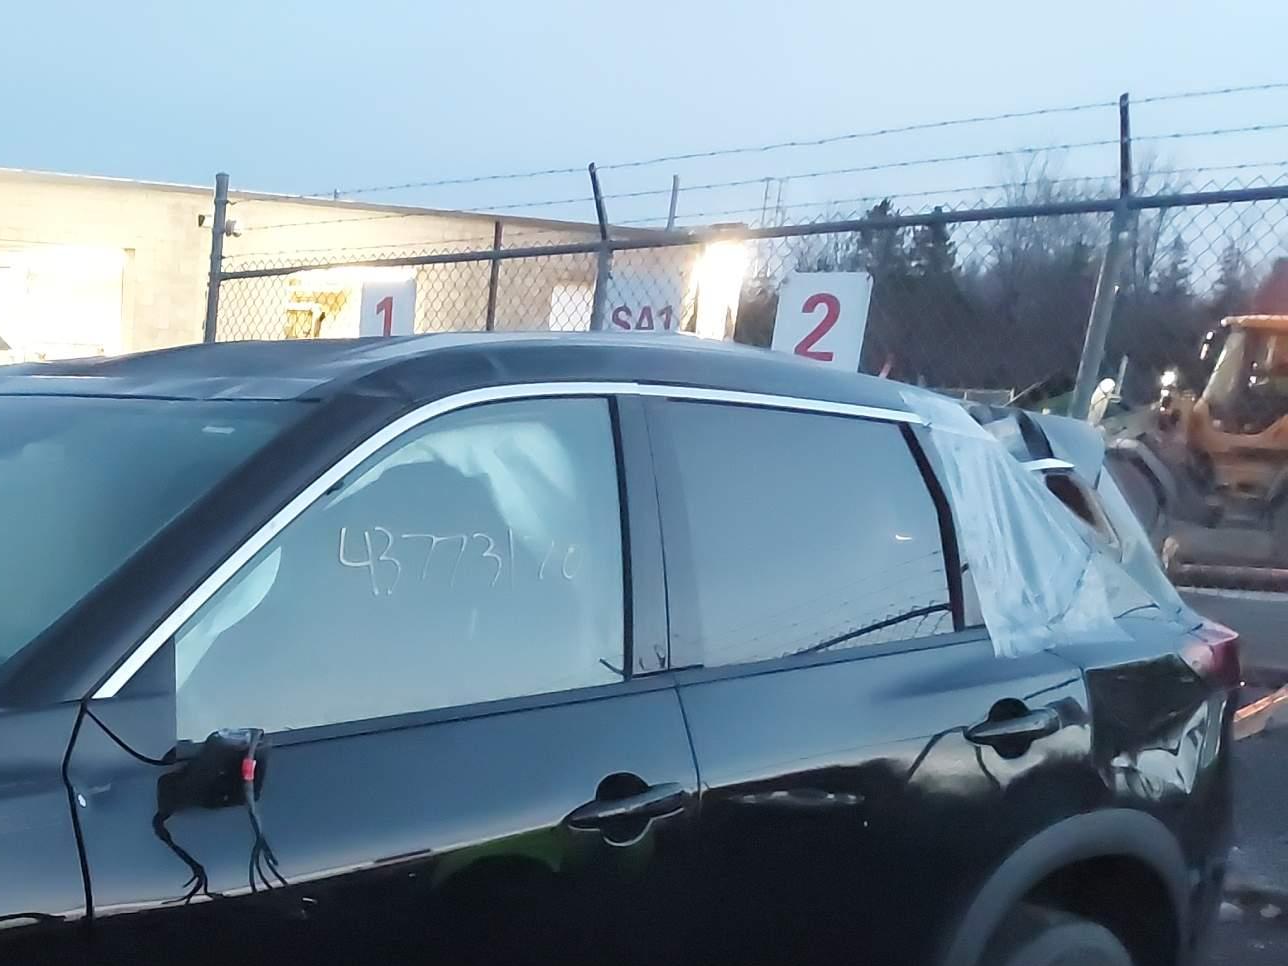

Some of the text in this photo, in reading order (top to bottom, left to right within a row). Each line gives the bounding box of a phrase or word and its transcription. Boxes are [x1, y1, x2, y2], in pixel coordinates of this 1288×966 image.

[375, 296, 394, 336] 1
[794, 293, 841, 361] 2
[339, 526, 582, 596] 43773170
